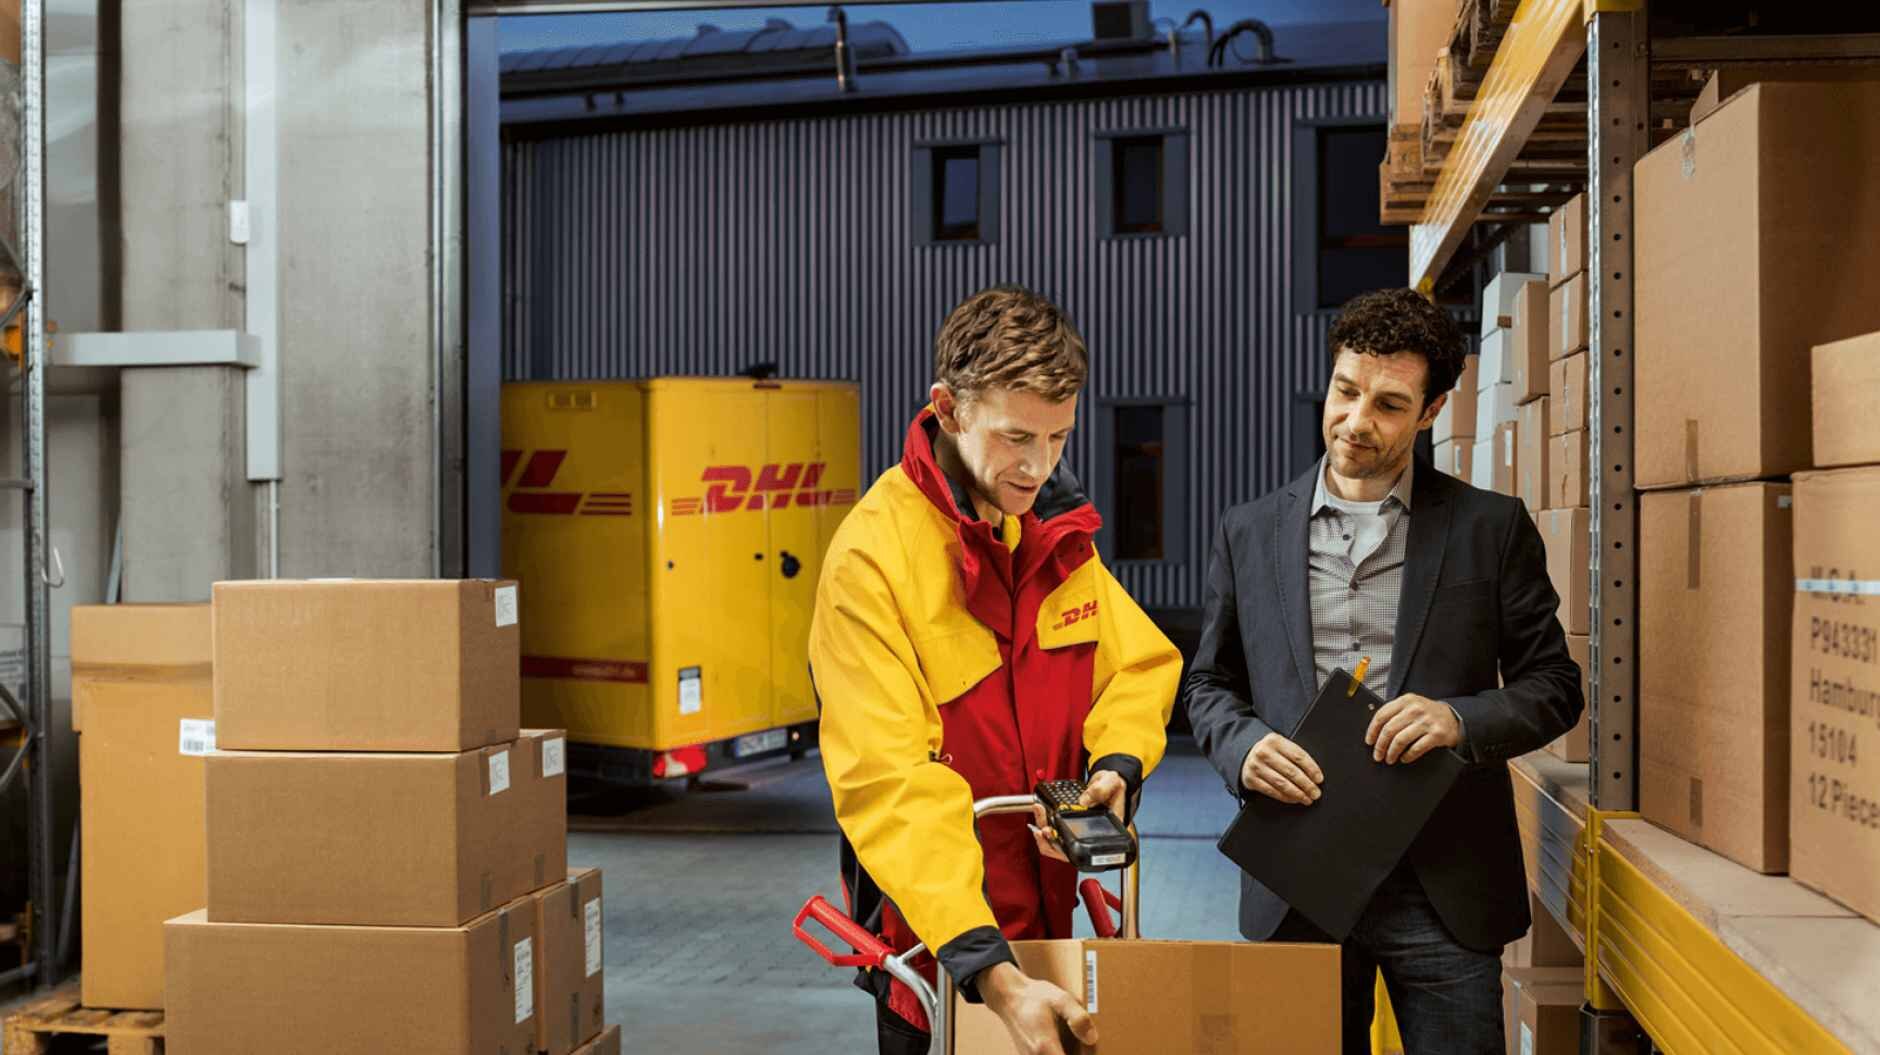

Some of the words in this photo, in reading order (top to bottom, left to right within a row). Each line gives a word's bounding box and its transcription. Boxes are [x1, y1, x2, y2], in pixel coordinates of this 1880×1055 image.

[701, 463, 836, 514] DHL
[1061, 600, 1098, 627] DH
[1808, 720, 1858, 767] 15104
[1809, 771, 1828, 810] 12
